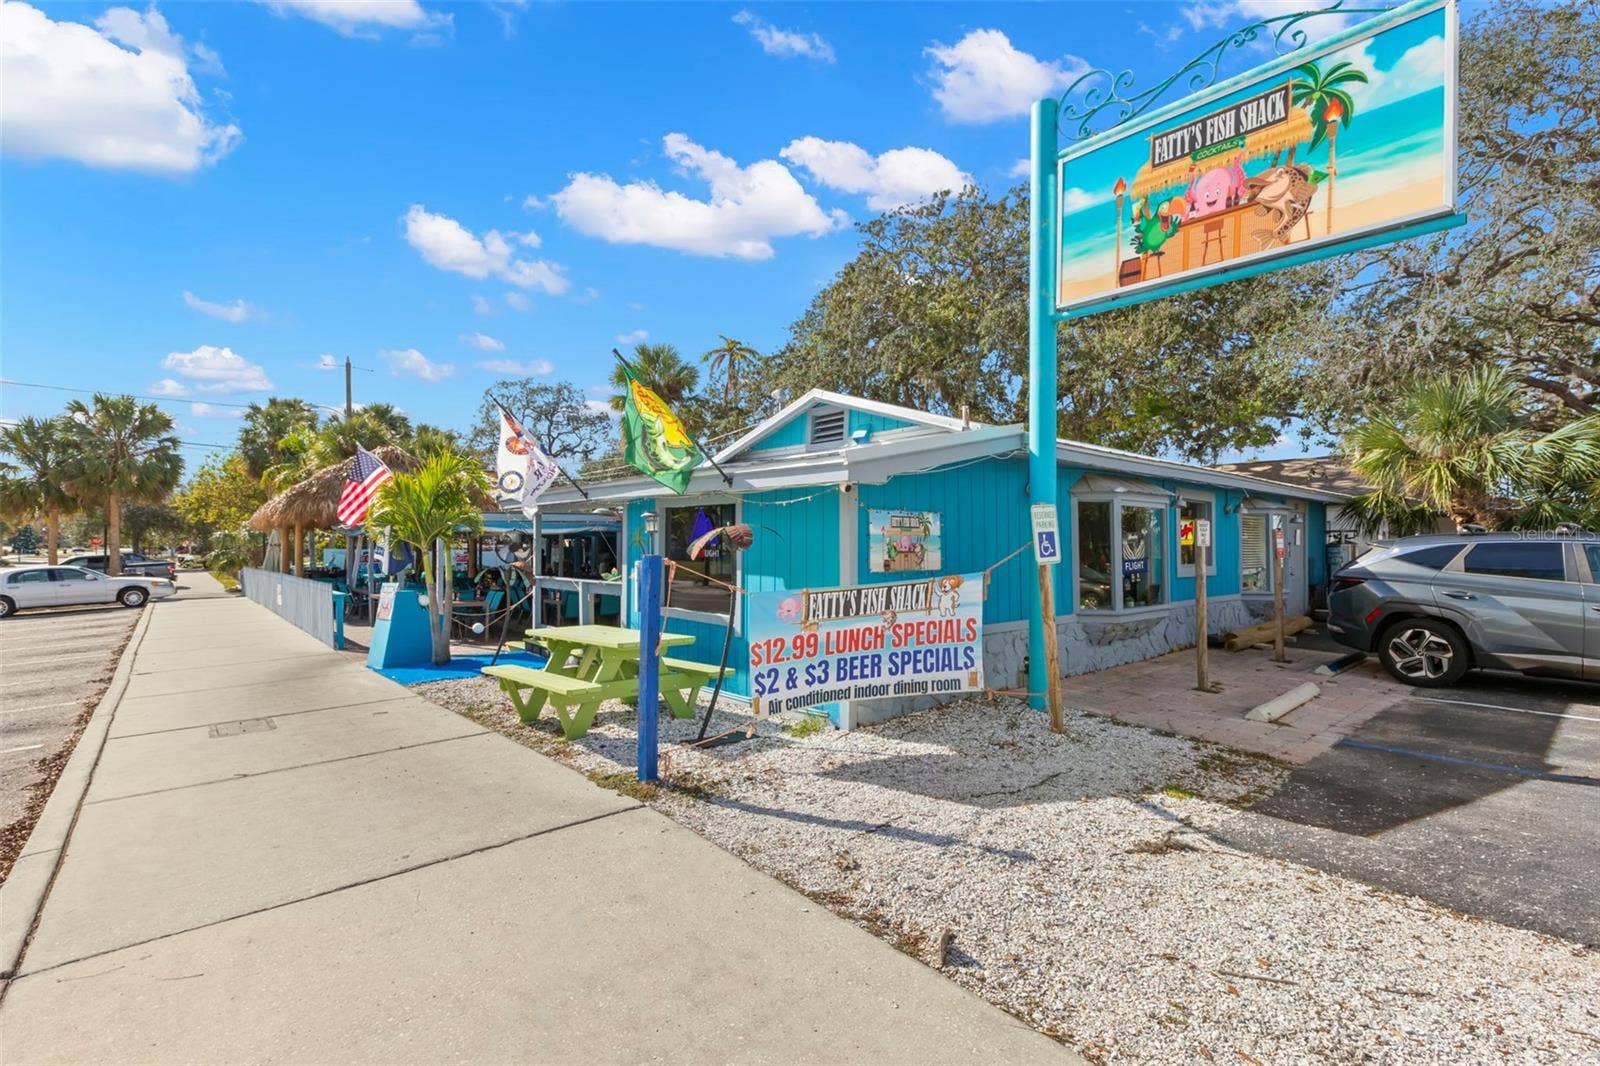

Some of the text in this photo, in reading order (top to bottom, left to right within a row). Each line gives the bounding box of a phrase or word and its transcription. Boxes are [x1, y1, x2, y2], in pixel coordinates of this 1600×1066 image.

[1154, 90, 1286, 165] FATTY'S FISH SHACK
[1197, 141, 1238, 160] COCKTAILS
[1125, 561, 1144, 571] FLIGHT
[808, 583, 928, 621] FATTY'S FISH SHACK
[750, 617, 978, 668] $12.99 LUNCH SPECIALS
[754, 646, 975, 698] $2 & $3 BEER SPECIALS
[768, 678, 961, 716] Air conditioned indoor dining room
